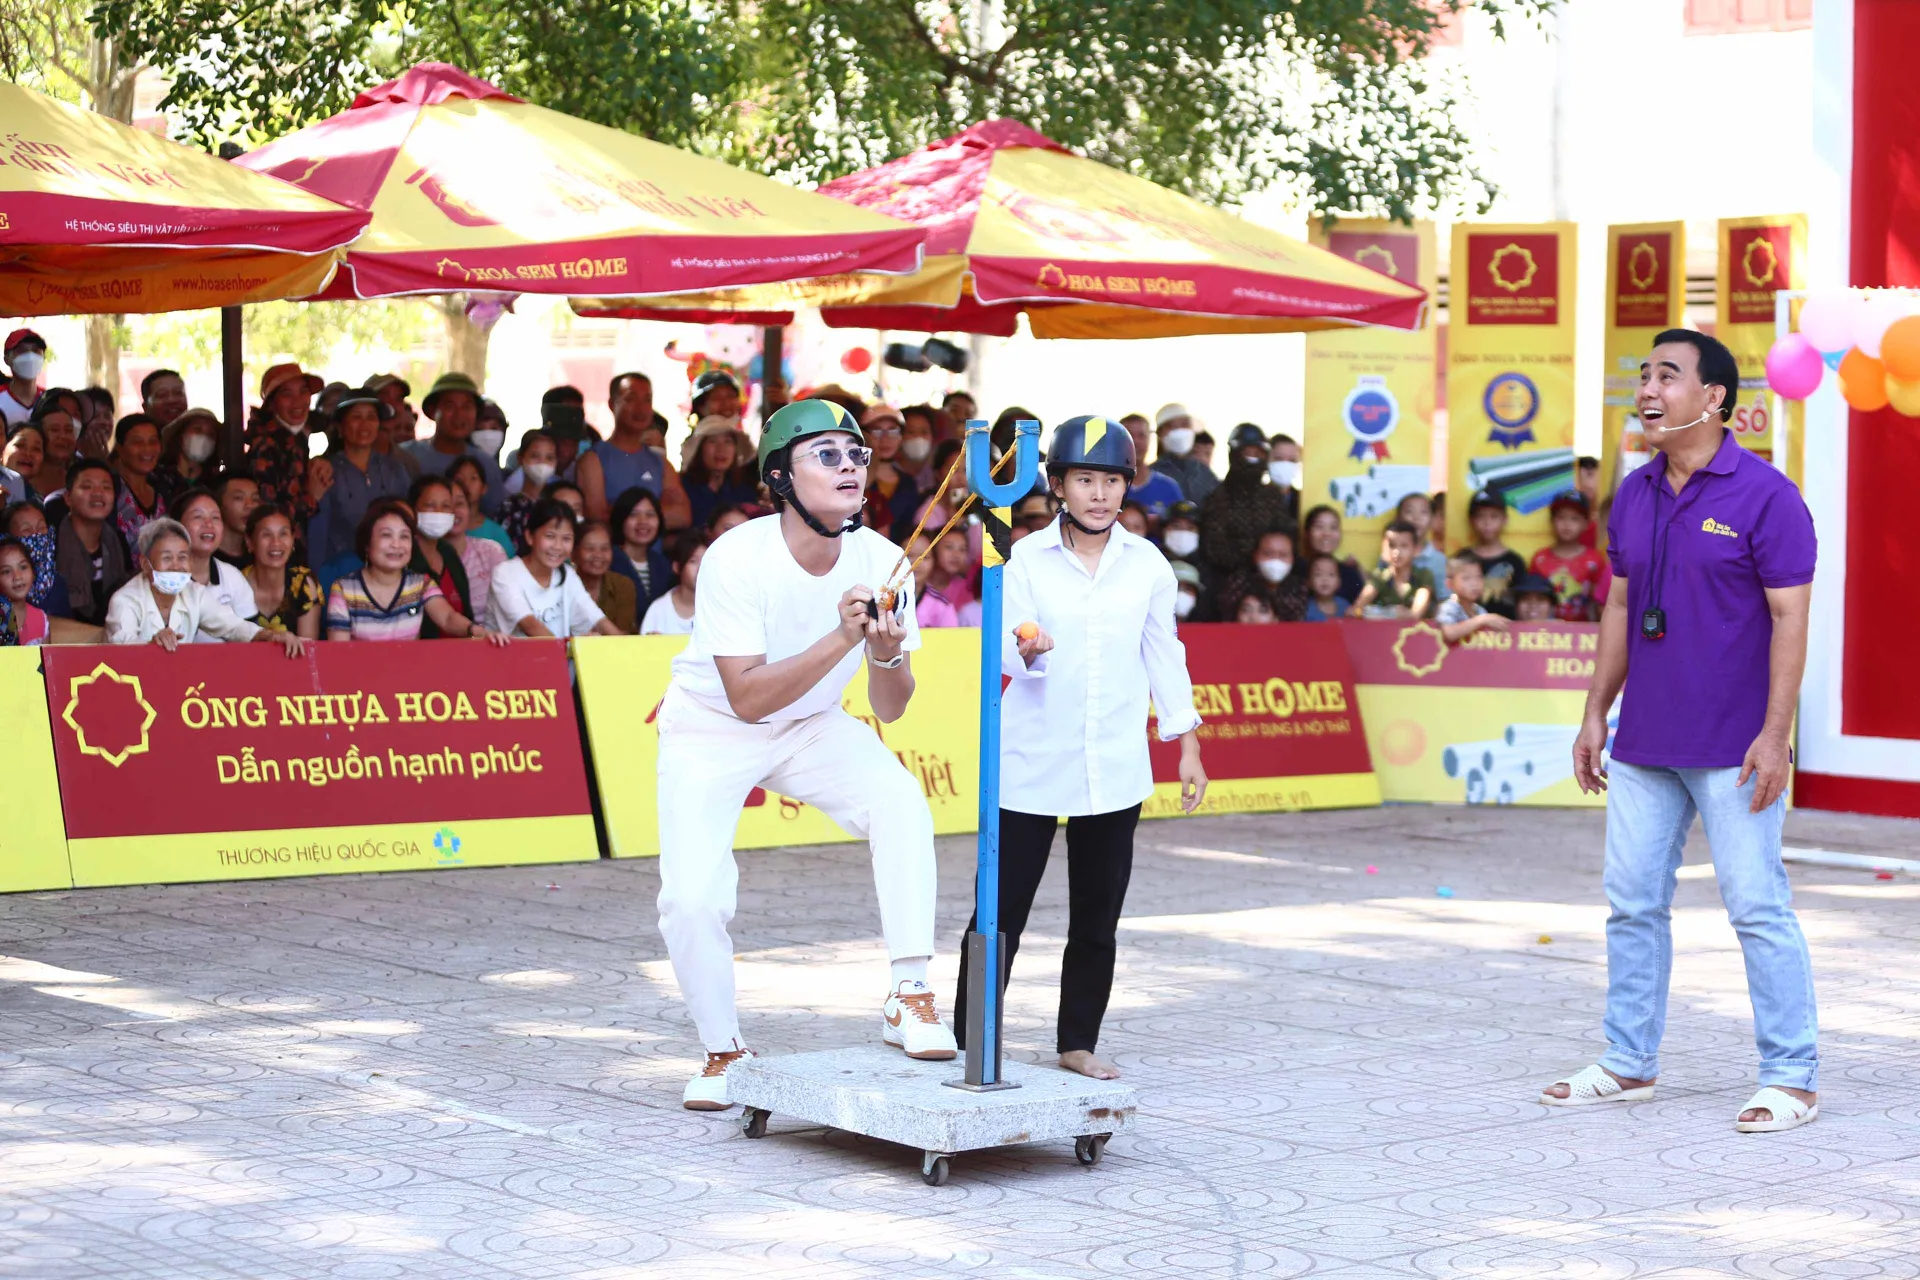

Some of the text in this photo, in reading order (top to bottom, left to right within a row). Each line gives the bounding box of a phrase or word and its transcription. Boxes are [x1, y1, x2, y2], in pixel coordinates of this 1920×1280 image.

[65, 219, 79, 232] HỆ
[80, 219, 116, 233] THỐNG
[118, 222, 138, 234] SIÊU
[470, 257, 628, 281] HOA SEN HOME
[101, 279, 143, 299] HOME
[1067, 273, 1197, 296] HOA SEN HOME
[181, 682, 559, 731] ỐNG NHỰA HOA SEN
[1192, 684, 1234, 716] EN
[1238, 677, 1348, 718] HOME
[217, 743, 544, 787] Dẫn nguồn hạnh phúc
[217, 838, 421, 866] THƯƠNG HIỆU QUỐC GIA
